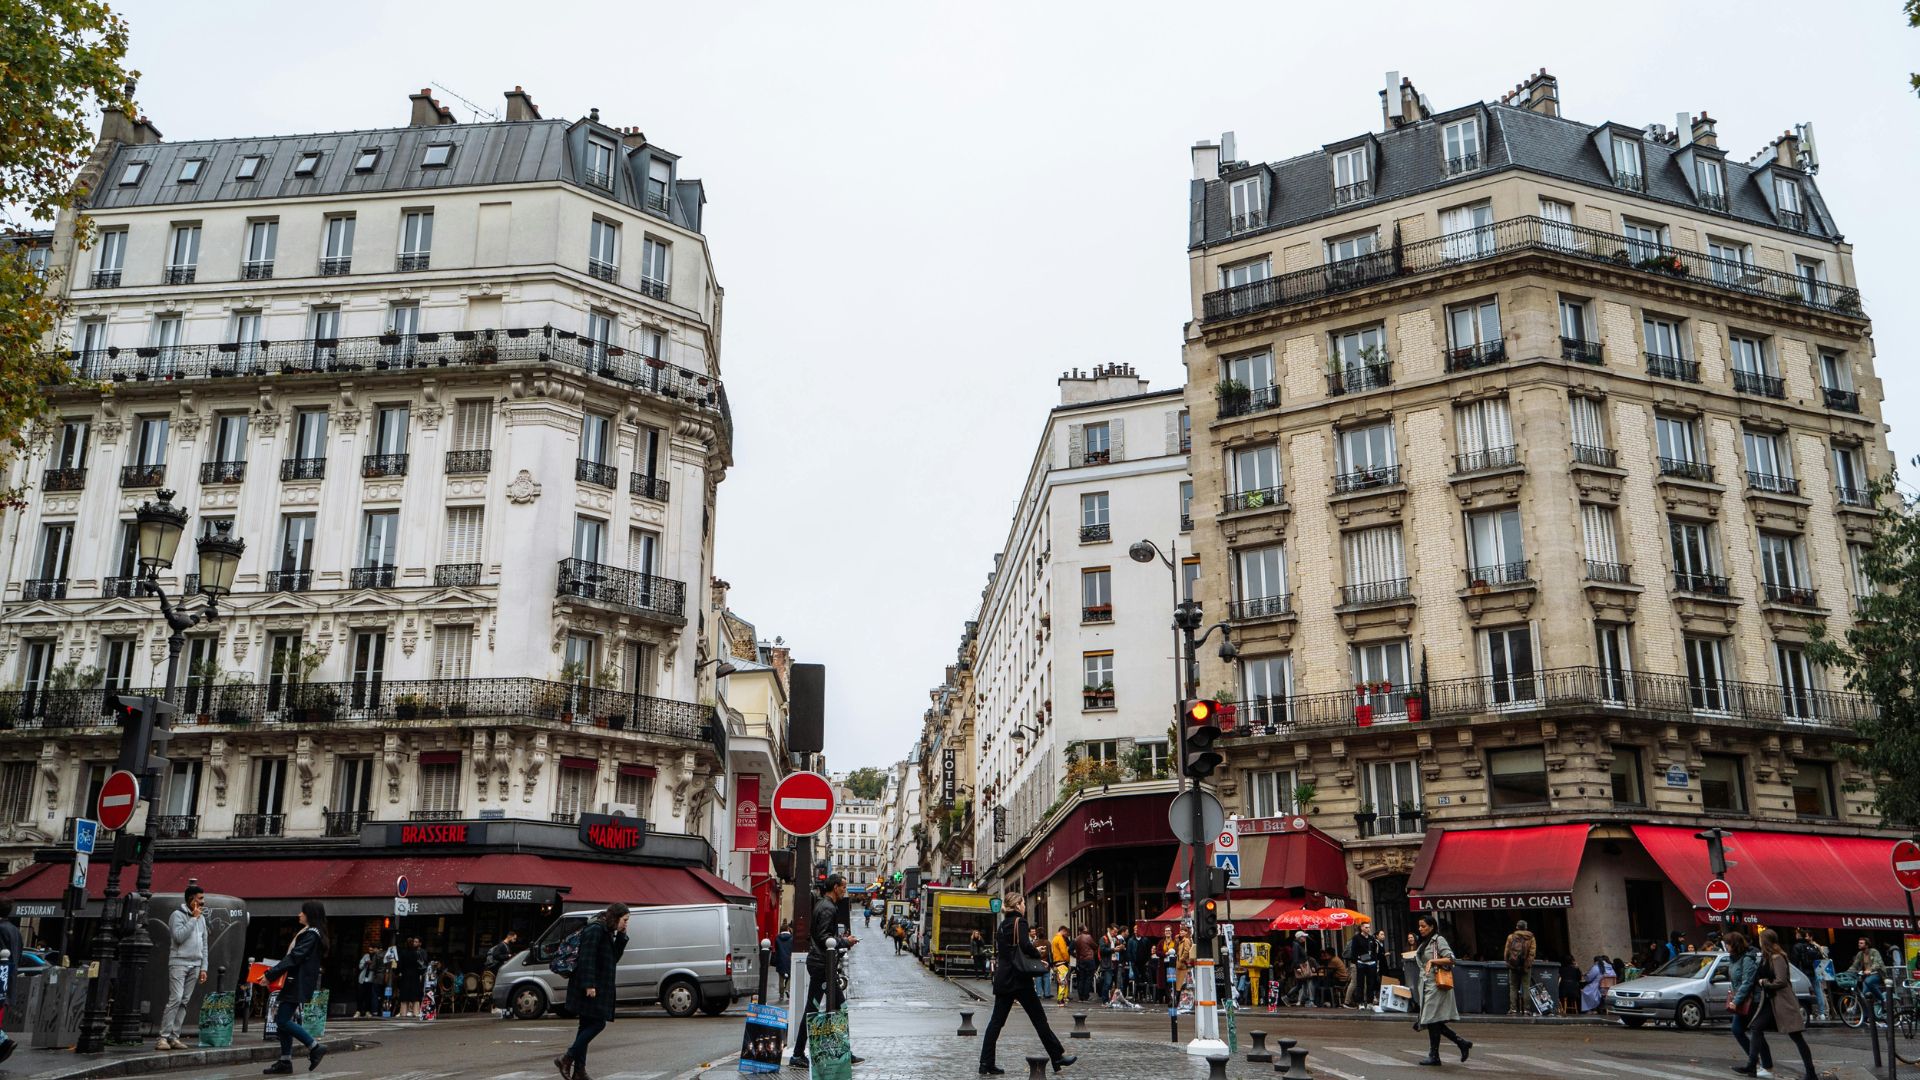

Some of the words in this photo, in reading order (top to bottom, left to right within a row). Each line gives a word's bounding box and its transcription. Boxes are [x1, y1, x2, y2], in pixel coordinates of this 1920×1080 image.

[944, 750, 954, 800] HOTEL
[1263, 820, 1286, 831] Bar
[402, 825, 467, 843] BRASSERIE
[588, 823, 640, 849] MARMITE
[497, 890, 532, 900] BRASSERIE
[1418, 900, 1433, 910] LA
[1436, 898, 1487, 909] CANTINE
[1491, 898, 1506, 908] DE
[1510, 897, 1525, 907] LA
[1528, 895, 1571, 907] CIGALE
[16, 905, 56, 916] RESTAURANT
[1842, 917, 1854, 927] LA
[1855, 917, 1892, 928] CANTINE
[1893, 919, 1905, 928] DE
[1906, 919, 1913, 929] L
